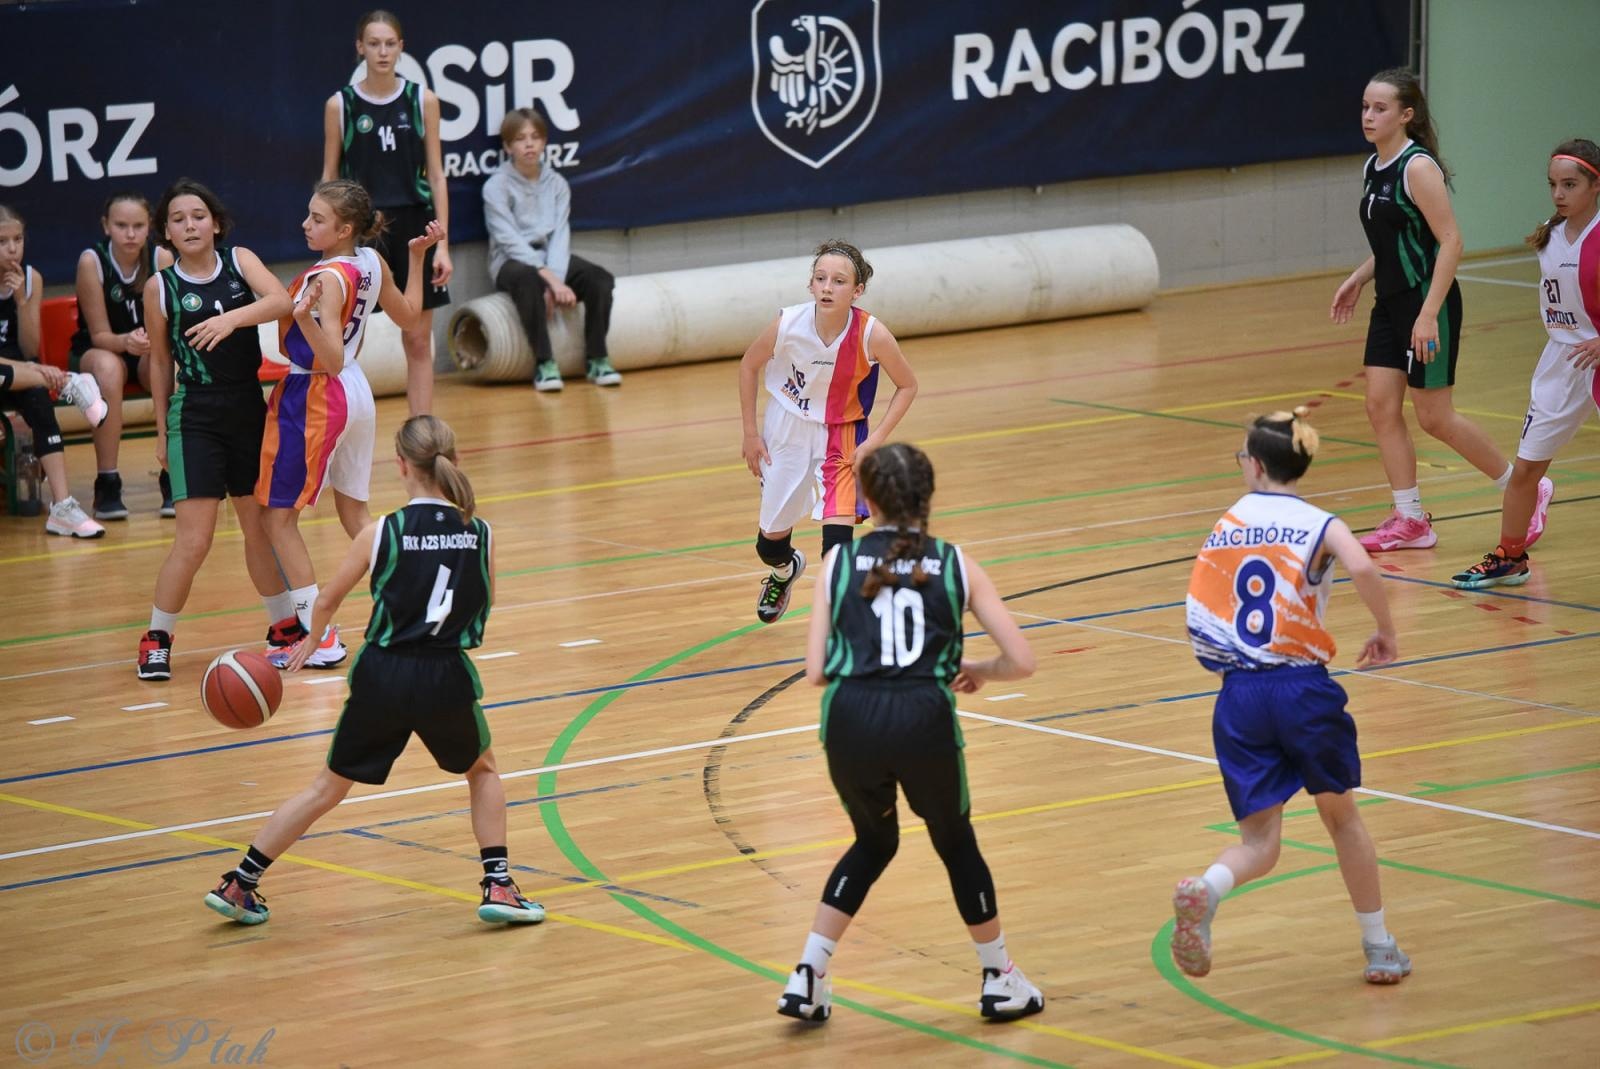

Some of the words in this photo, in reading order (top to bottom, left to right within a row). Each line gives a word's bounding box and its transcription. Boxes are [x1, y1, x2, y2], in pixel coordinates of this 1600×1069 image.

[952, 0, 1305, 100] RACIBÓRZ
[0, 84, 158, 188] ÓRZ
[378, 125, 396, 151] 14
[1367, 193, 1376, 220] 7
[1543, 278, 1561, 304] 27
[1545, 307, 1578, 326] MINI
[421, 534, 439, 551] AZS
[1205, 521, 1310, 548] RACIBÓRZ
[425, 563, 454, 636] 4
[1235, 557, 1277, 649] 8
[870, 586, 926, 668] 10
